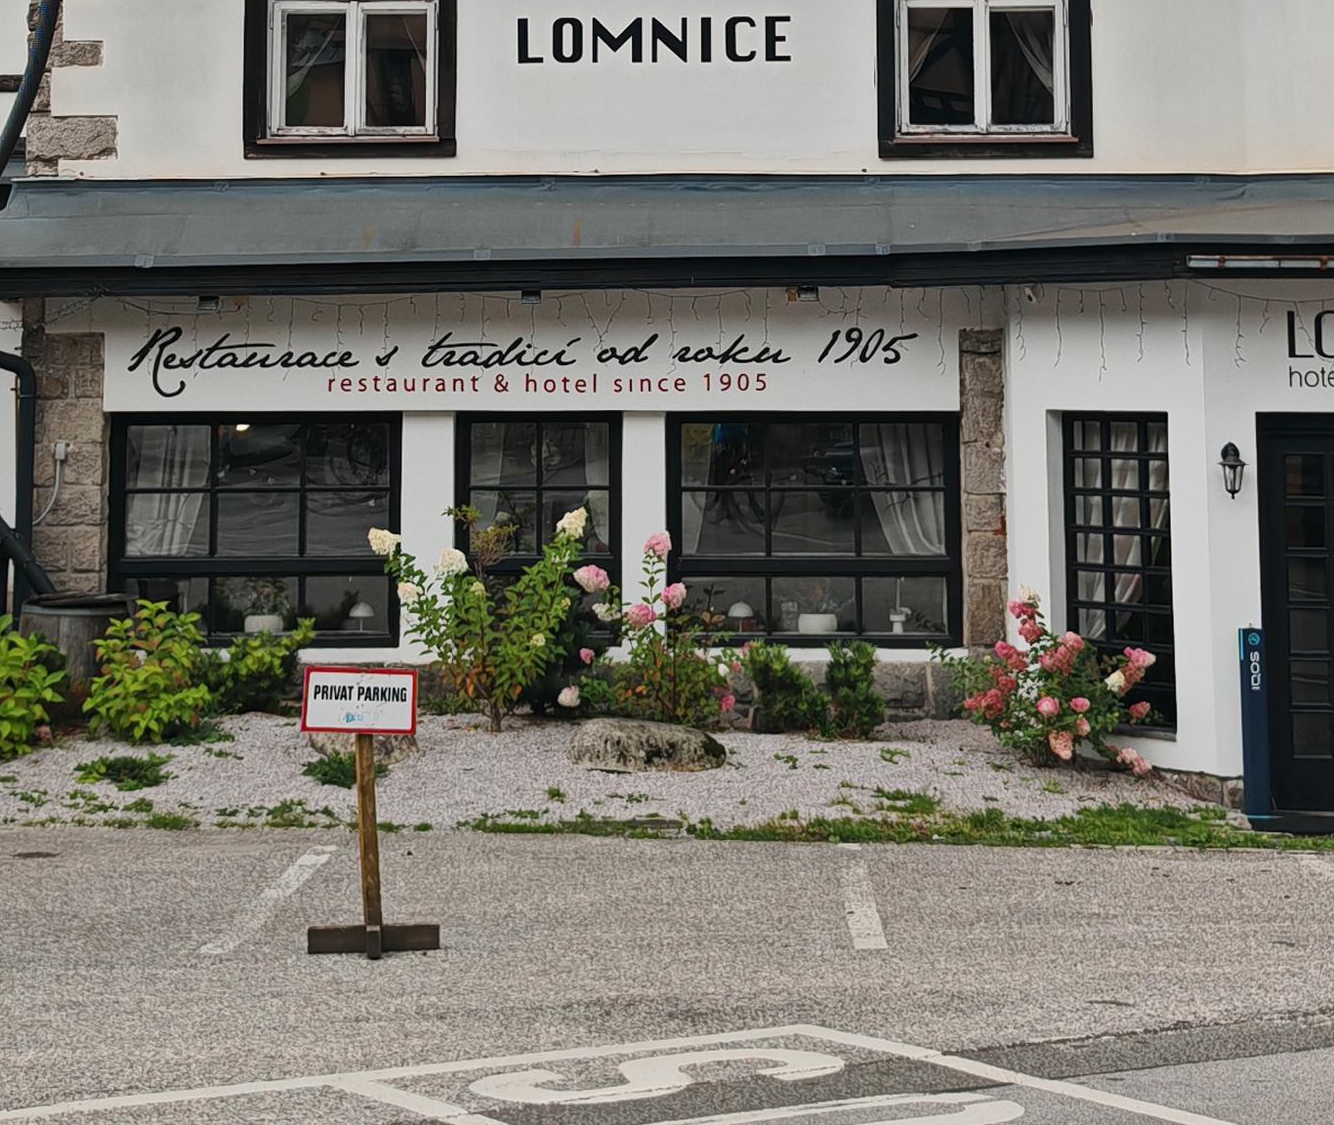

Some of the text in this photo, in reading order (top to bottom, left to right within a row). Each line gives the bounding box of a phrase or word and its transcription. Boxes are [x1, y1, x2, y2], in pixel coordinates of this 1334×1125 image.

[517, 16, 792, 63] LOMNICE
[128, 326, 919, 398] Restaurace s tradicí od roku 1905
[328, 373, 767, 394] restaurant & hotel since 1905
[1249, 650, 1262, 691] IQOS
[313, 684, 407, 702] PRIVAT PARKING
